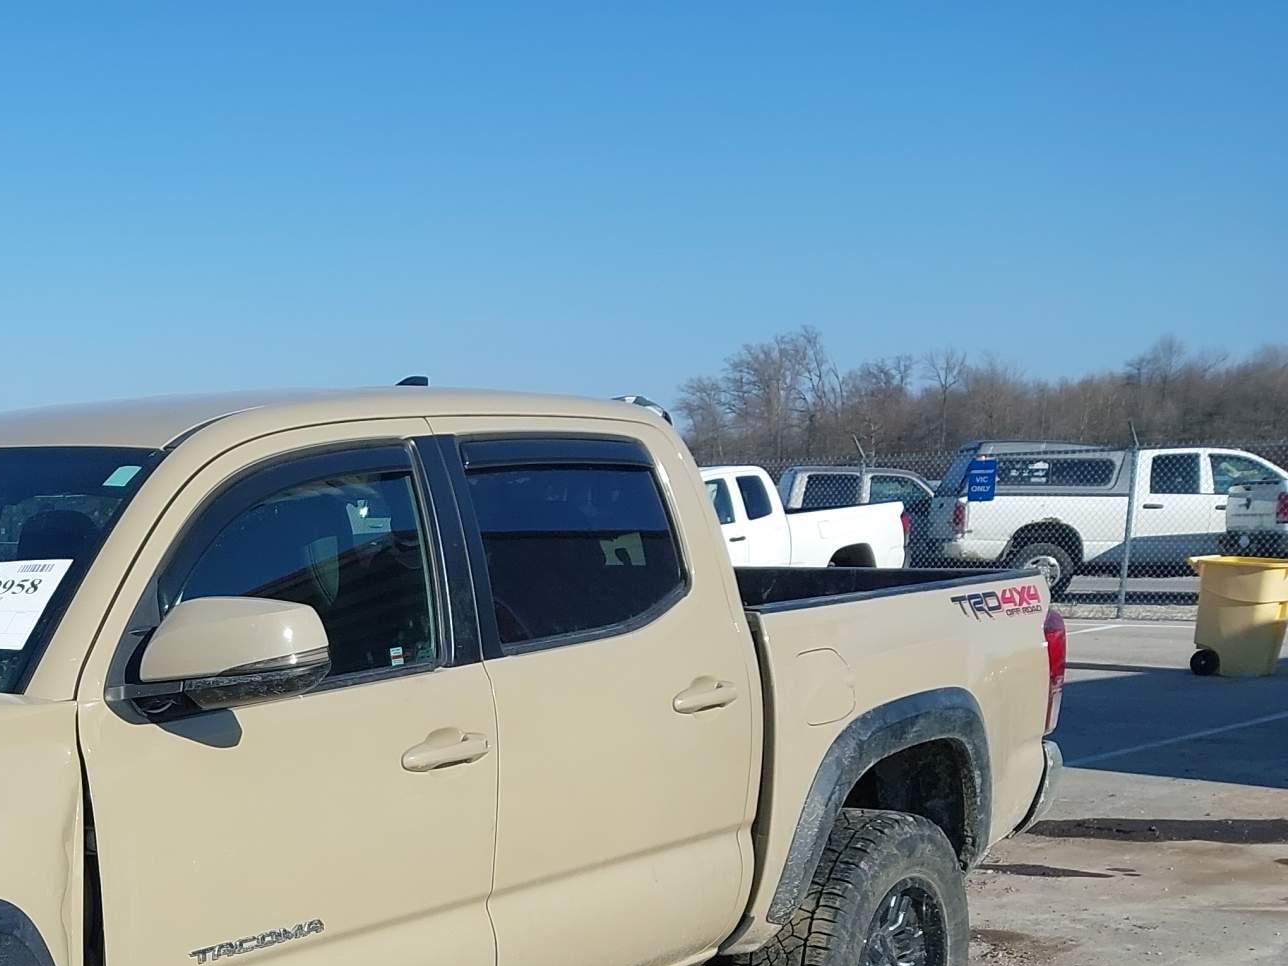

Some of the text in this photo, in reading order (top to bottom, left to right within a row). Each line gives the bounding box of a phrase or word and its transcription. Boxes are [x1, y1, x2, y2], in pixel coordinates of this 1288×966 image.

[950, 591, 1002, 622] TRD
[1005, 606, 1042, 616] OFF ROAD
[188, 919, 325, 965] TACOMA
